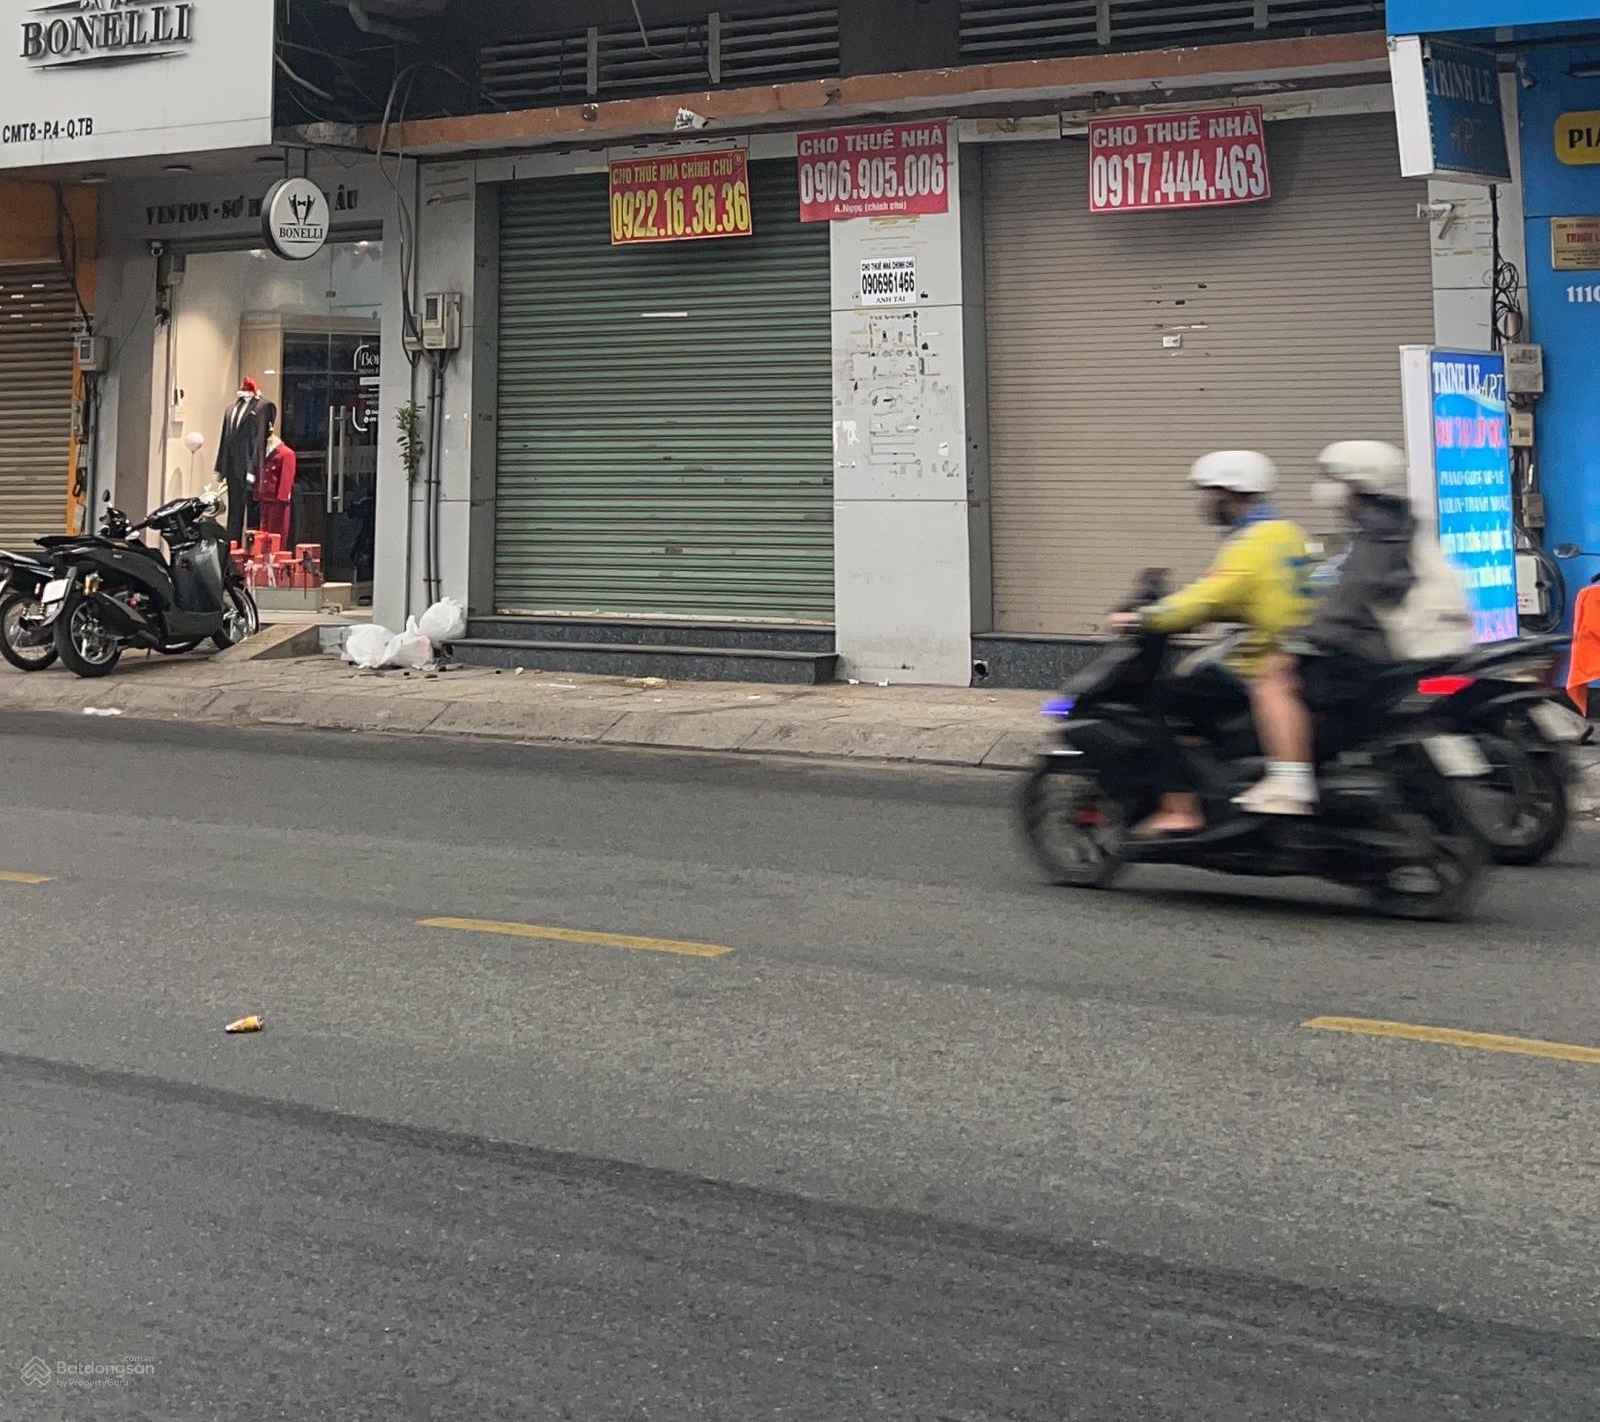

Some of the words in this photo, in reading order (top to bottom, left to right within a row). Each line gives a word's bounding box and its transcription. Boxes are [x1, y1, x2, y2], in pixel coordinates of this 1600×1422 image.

[20, 4, 191, 58] BONELLI
[801, 137, 838, 156] CHO
[845, 129, 894, 151] THUÊ
[902, 125, 944, 148] NHÀ
[1093, 126, 1137, 147] CHO
[1144, 116, 1200, 144] THUÊ
[1209, 110, 1258, 138] NHÀ
[613, 168, 631, 184] CHO
[634, 162, 657, 183] THUÊ
[660, 160, 679, 181] NHÀ
[801, 153, 944, 204] 0906.905.006
[1093, 144, 1264, 207] 0917.444.463
[146, 201, 211, 225] VESTON
[613, 180, 748, 239] 0922.16.36.36
[279, 228, 323, 239] BONELLI
[862, 271, 914, 294] 0906961466
